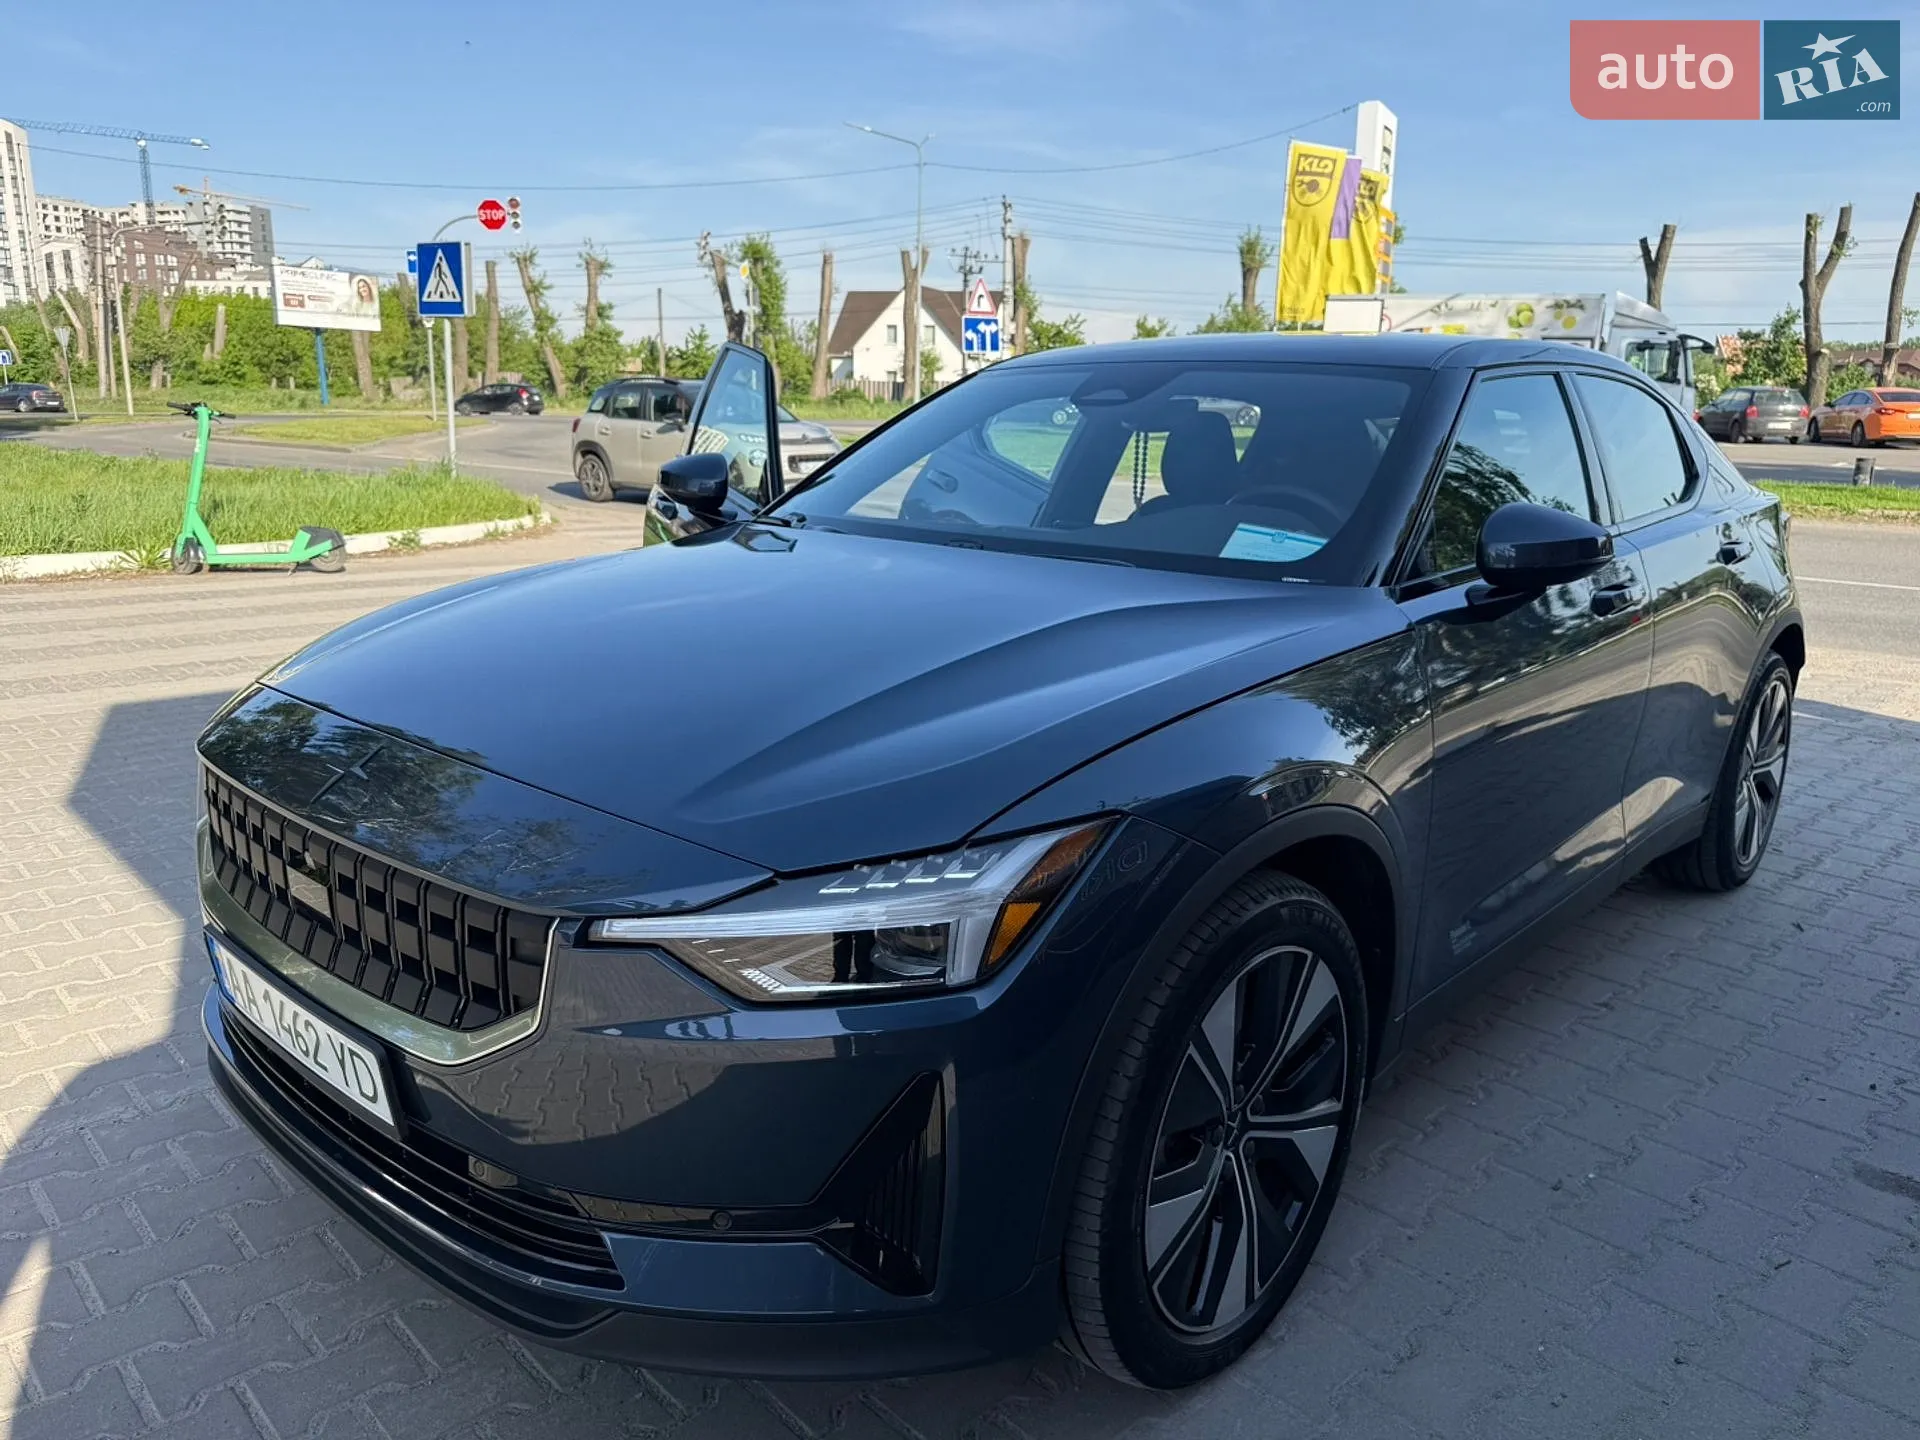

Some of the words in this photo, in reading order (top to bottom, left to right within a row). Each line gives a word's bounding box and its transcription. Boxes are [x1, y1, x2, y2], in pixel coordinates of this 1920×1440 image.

[1298, 156, 1334, 173] KLO
[479, 209, 506, 221] STOP
[263, 988, 329, 1074] 1462
[326, 1031, 379, 1104] YD
